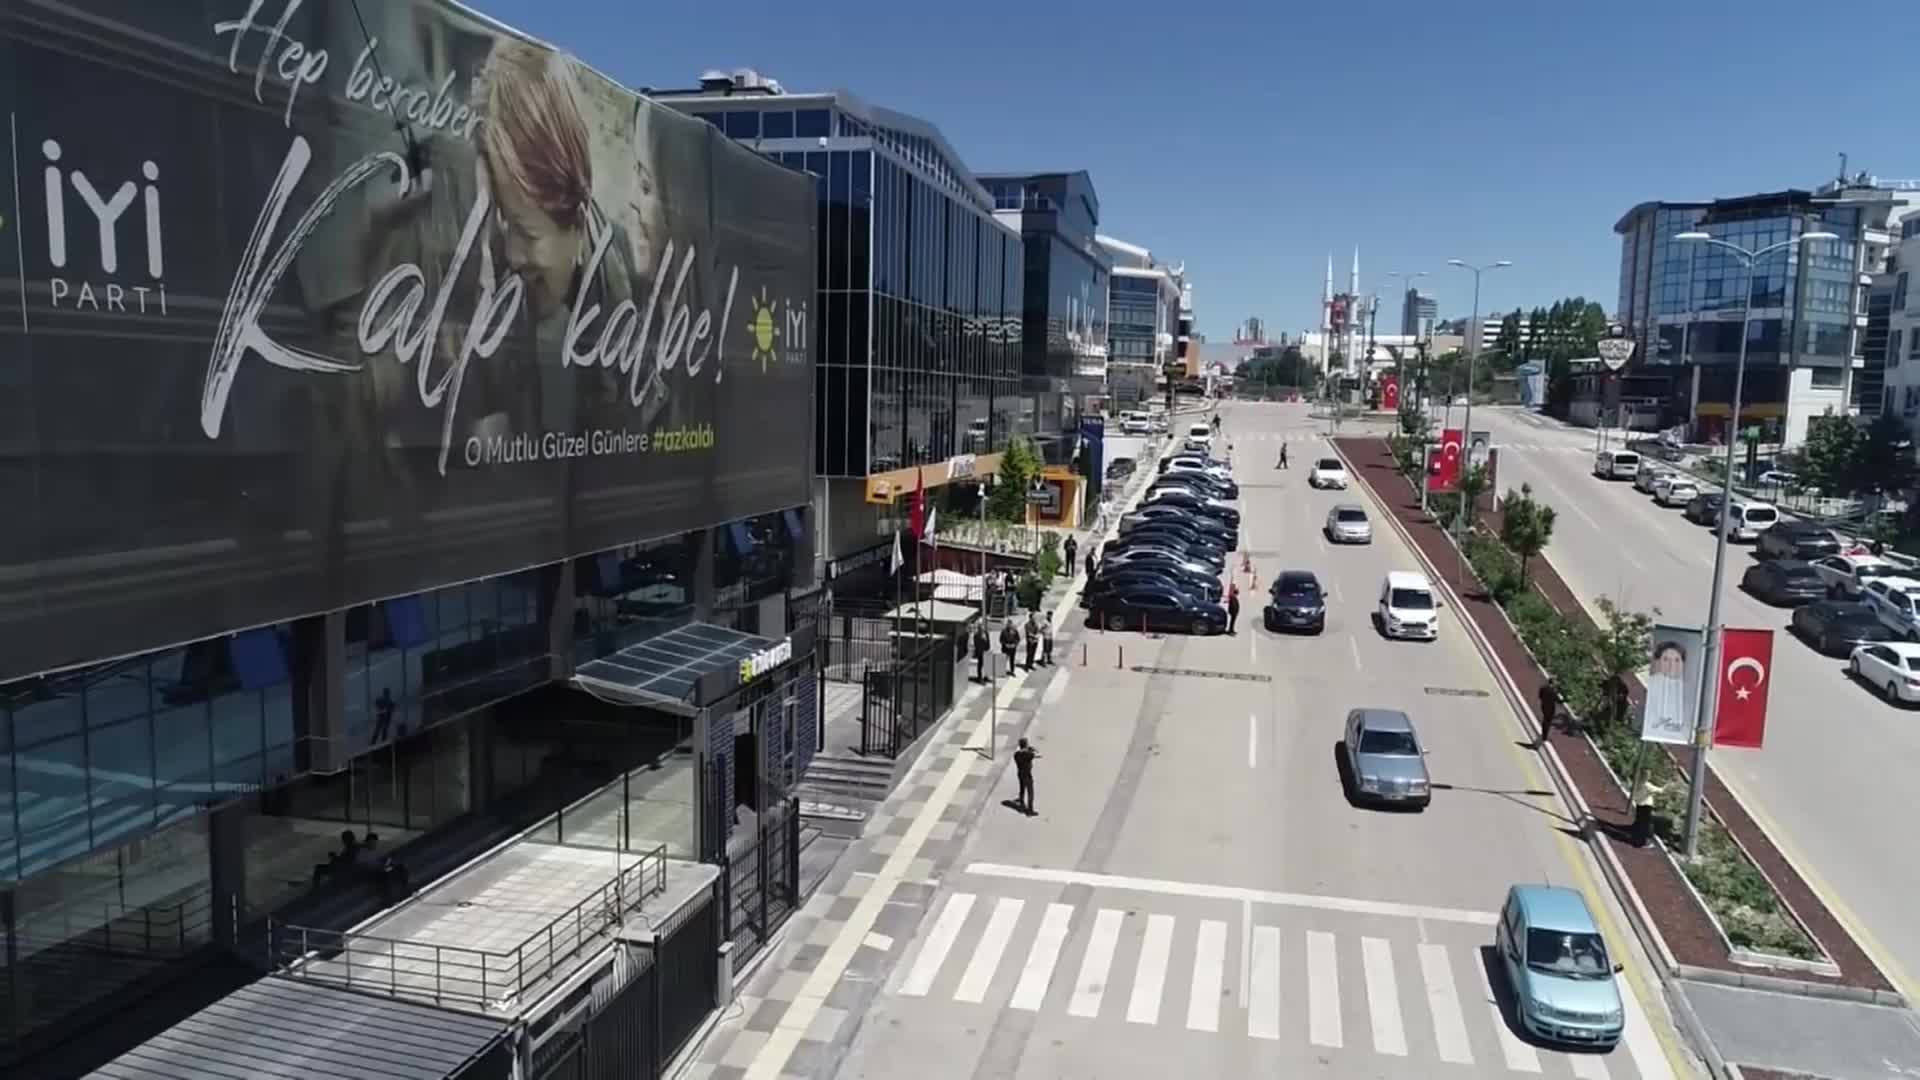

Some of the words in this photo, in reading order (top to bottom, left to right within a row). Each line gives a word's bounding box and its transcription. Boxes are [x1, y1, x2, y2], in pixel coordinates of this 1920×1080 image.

[214, 0, 328, 128] Hep
[346, 37, 484, 140] beraber
[51, 278, 166, 316] PARTİ
[201, 135, 525, 476] Kalp
[561, 218, 739, 406] kalbe!
[465, 437, 482, 466] O
[487, 432, 539, 463] Mutlu
[543, 431, 589, 459] Güzel
[592, 430, 649, 456] Günlere
[653, 424, 714, 451] #azkaldı
